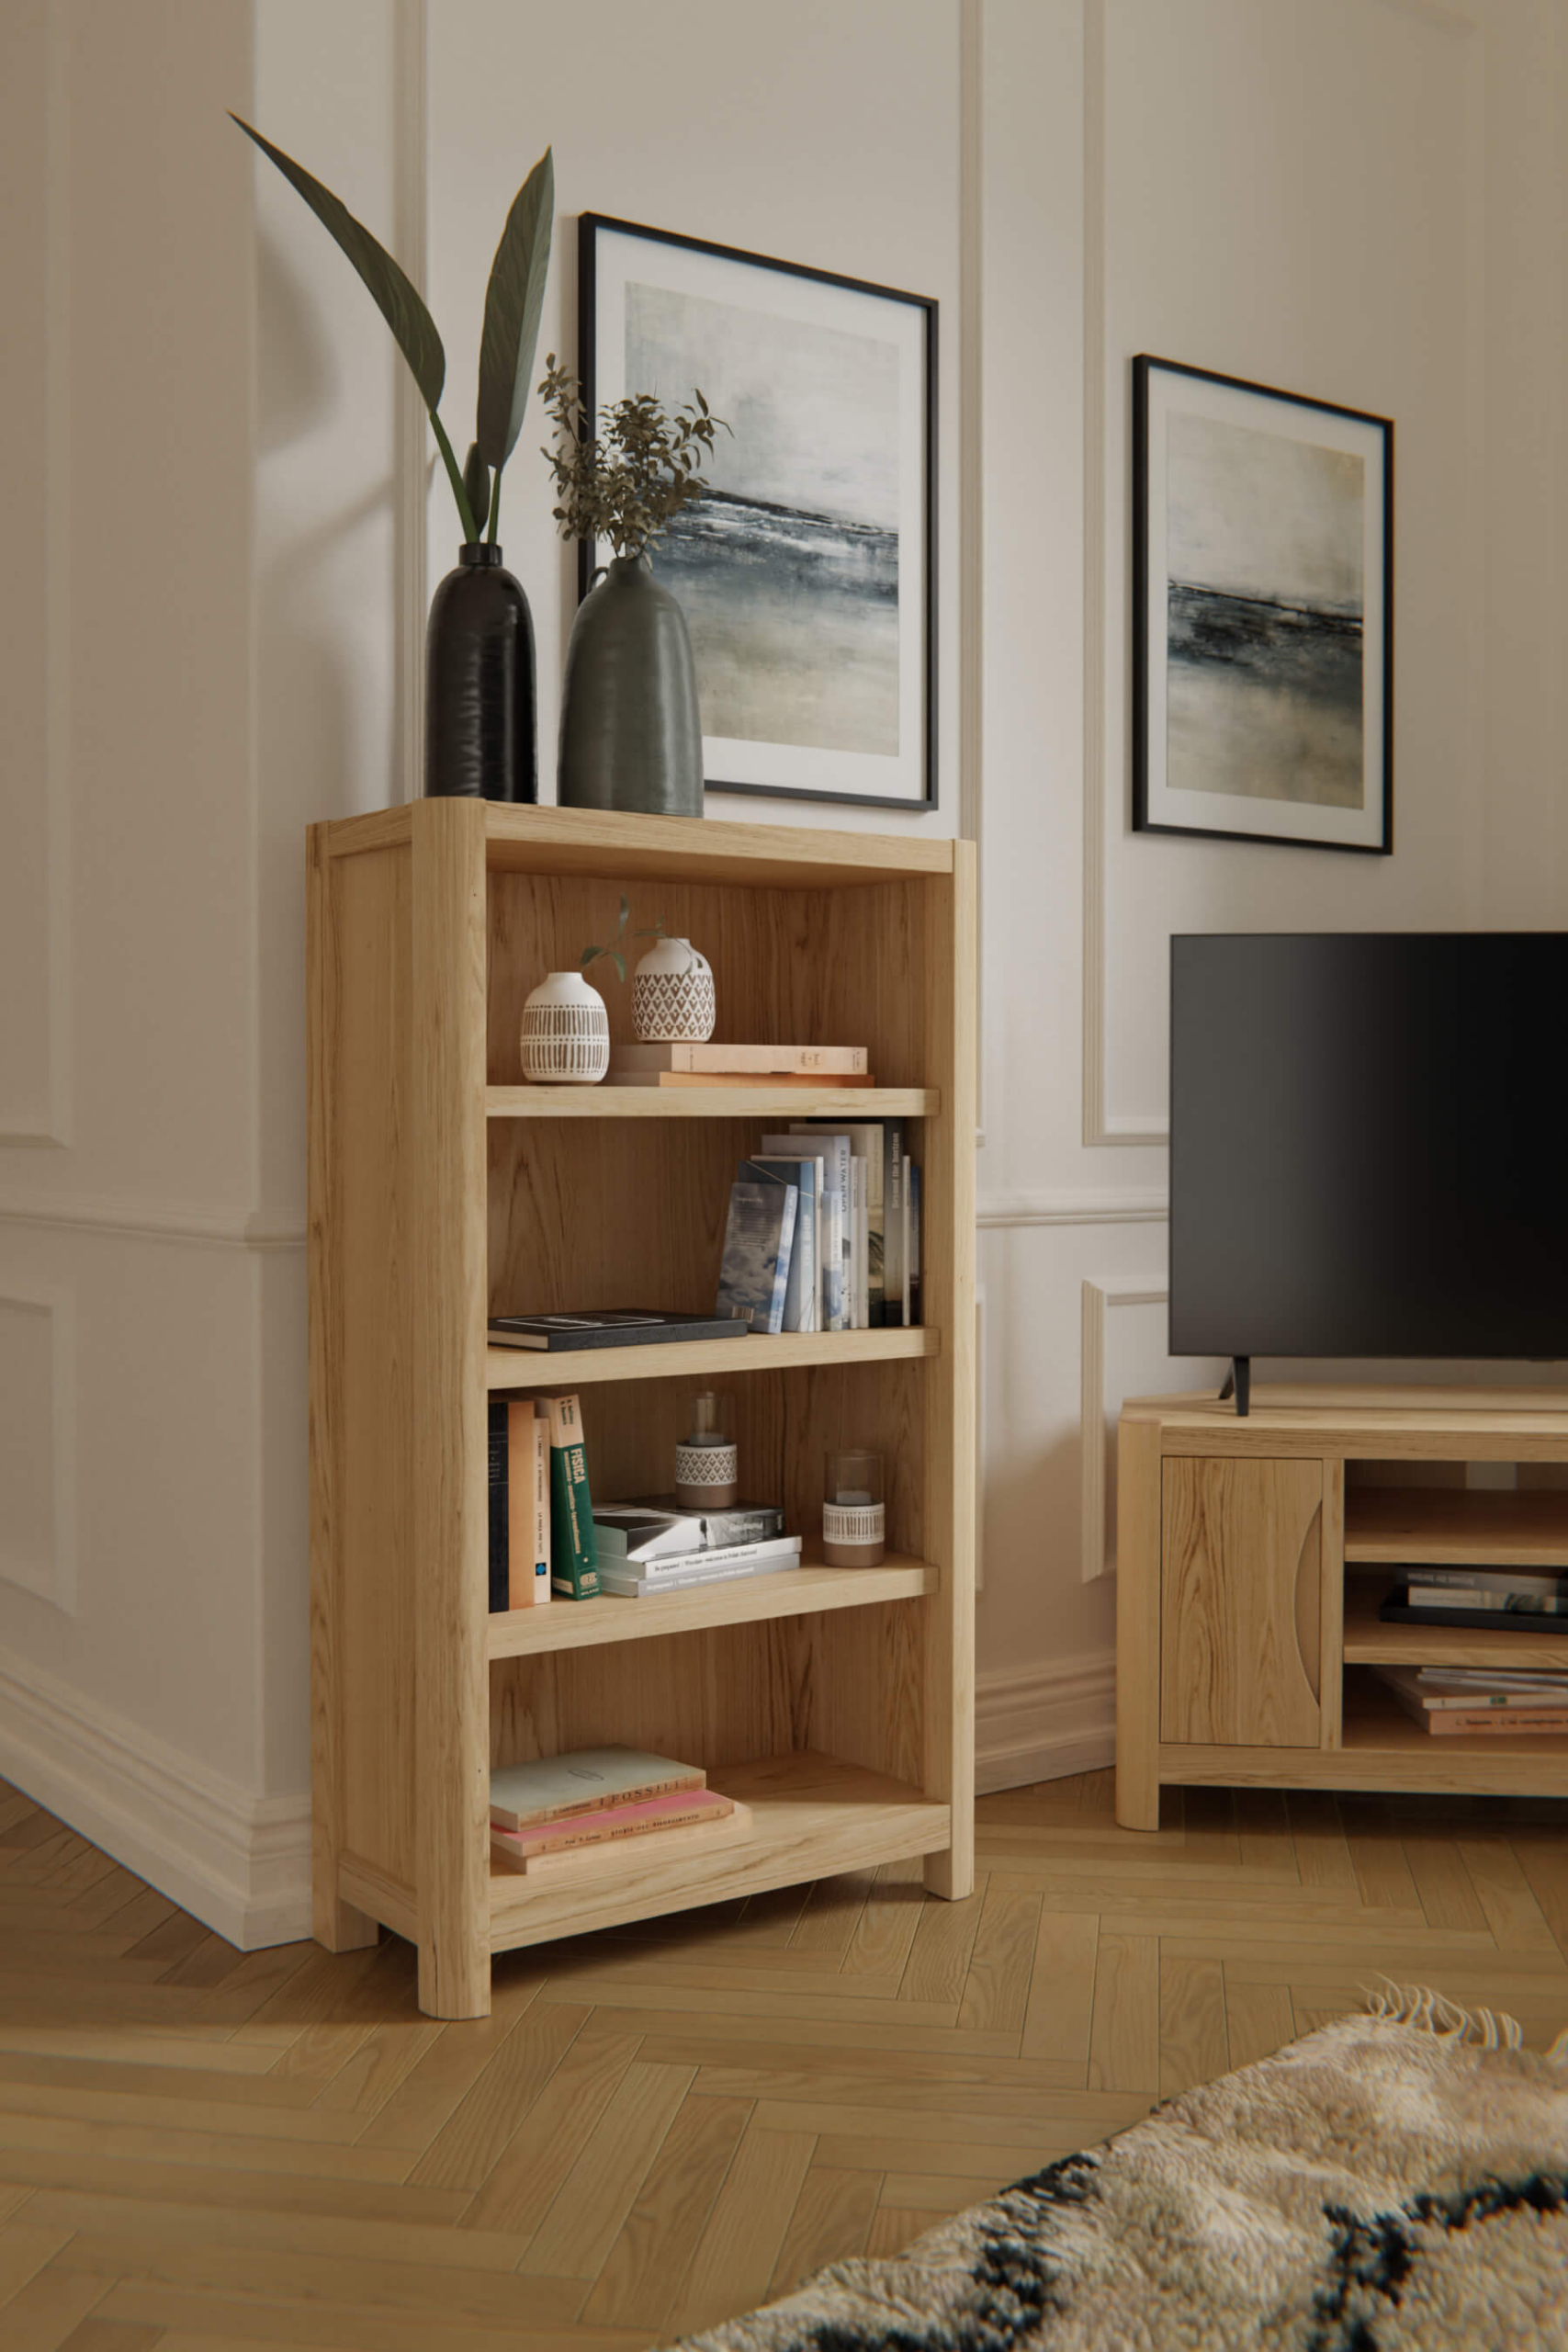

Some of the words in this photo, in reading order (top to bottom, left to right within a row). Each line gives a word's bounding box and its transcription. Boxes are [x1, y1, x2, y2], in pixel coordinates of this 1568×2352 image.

[892, 1133, 900, 1163] horizon
[840, 1149, 848, 1183] WATER
[892, 1165, 900, 1178] the
[892, 1179, 900, 1209] Beyond
[570, 1447, 586, 1485] FISICA
[611, 1781, 679, 1804] FOSSILI
